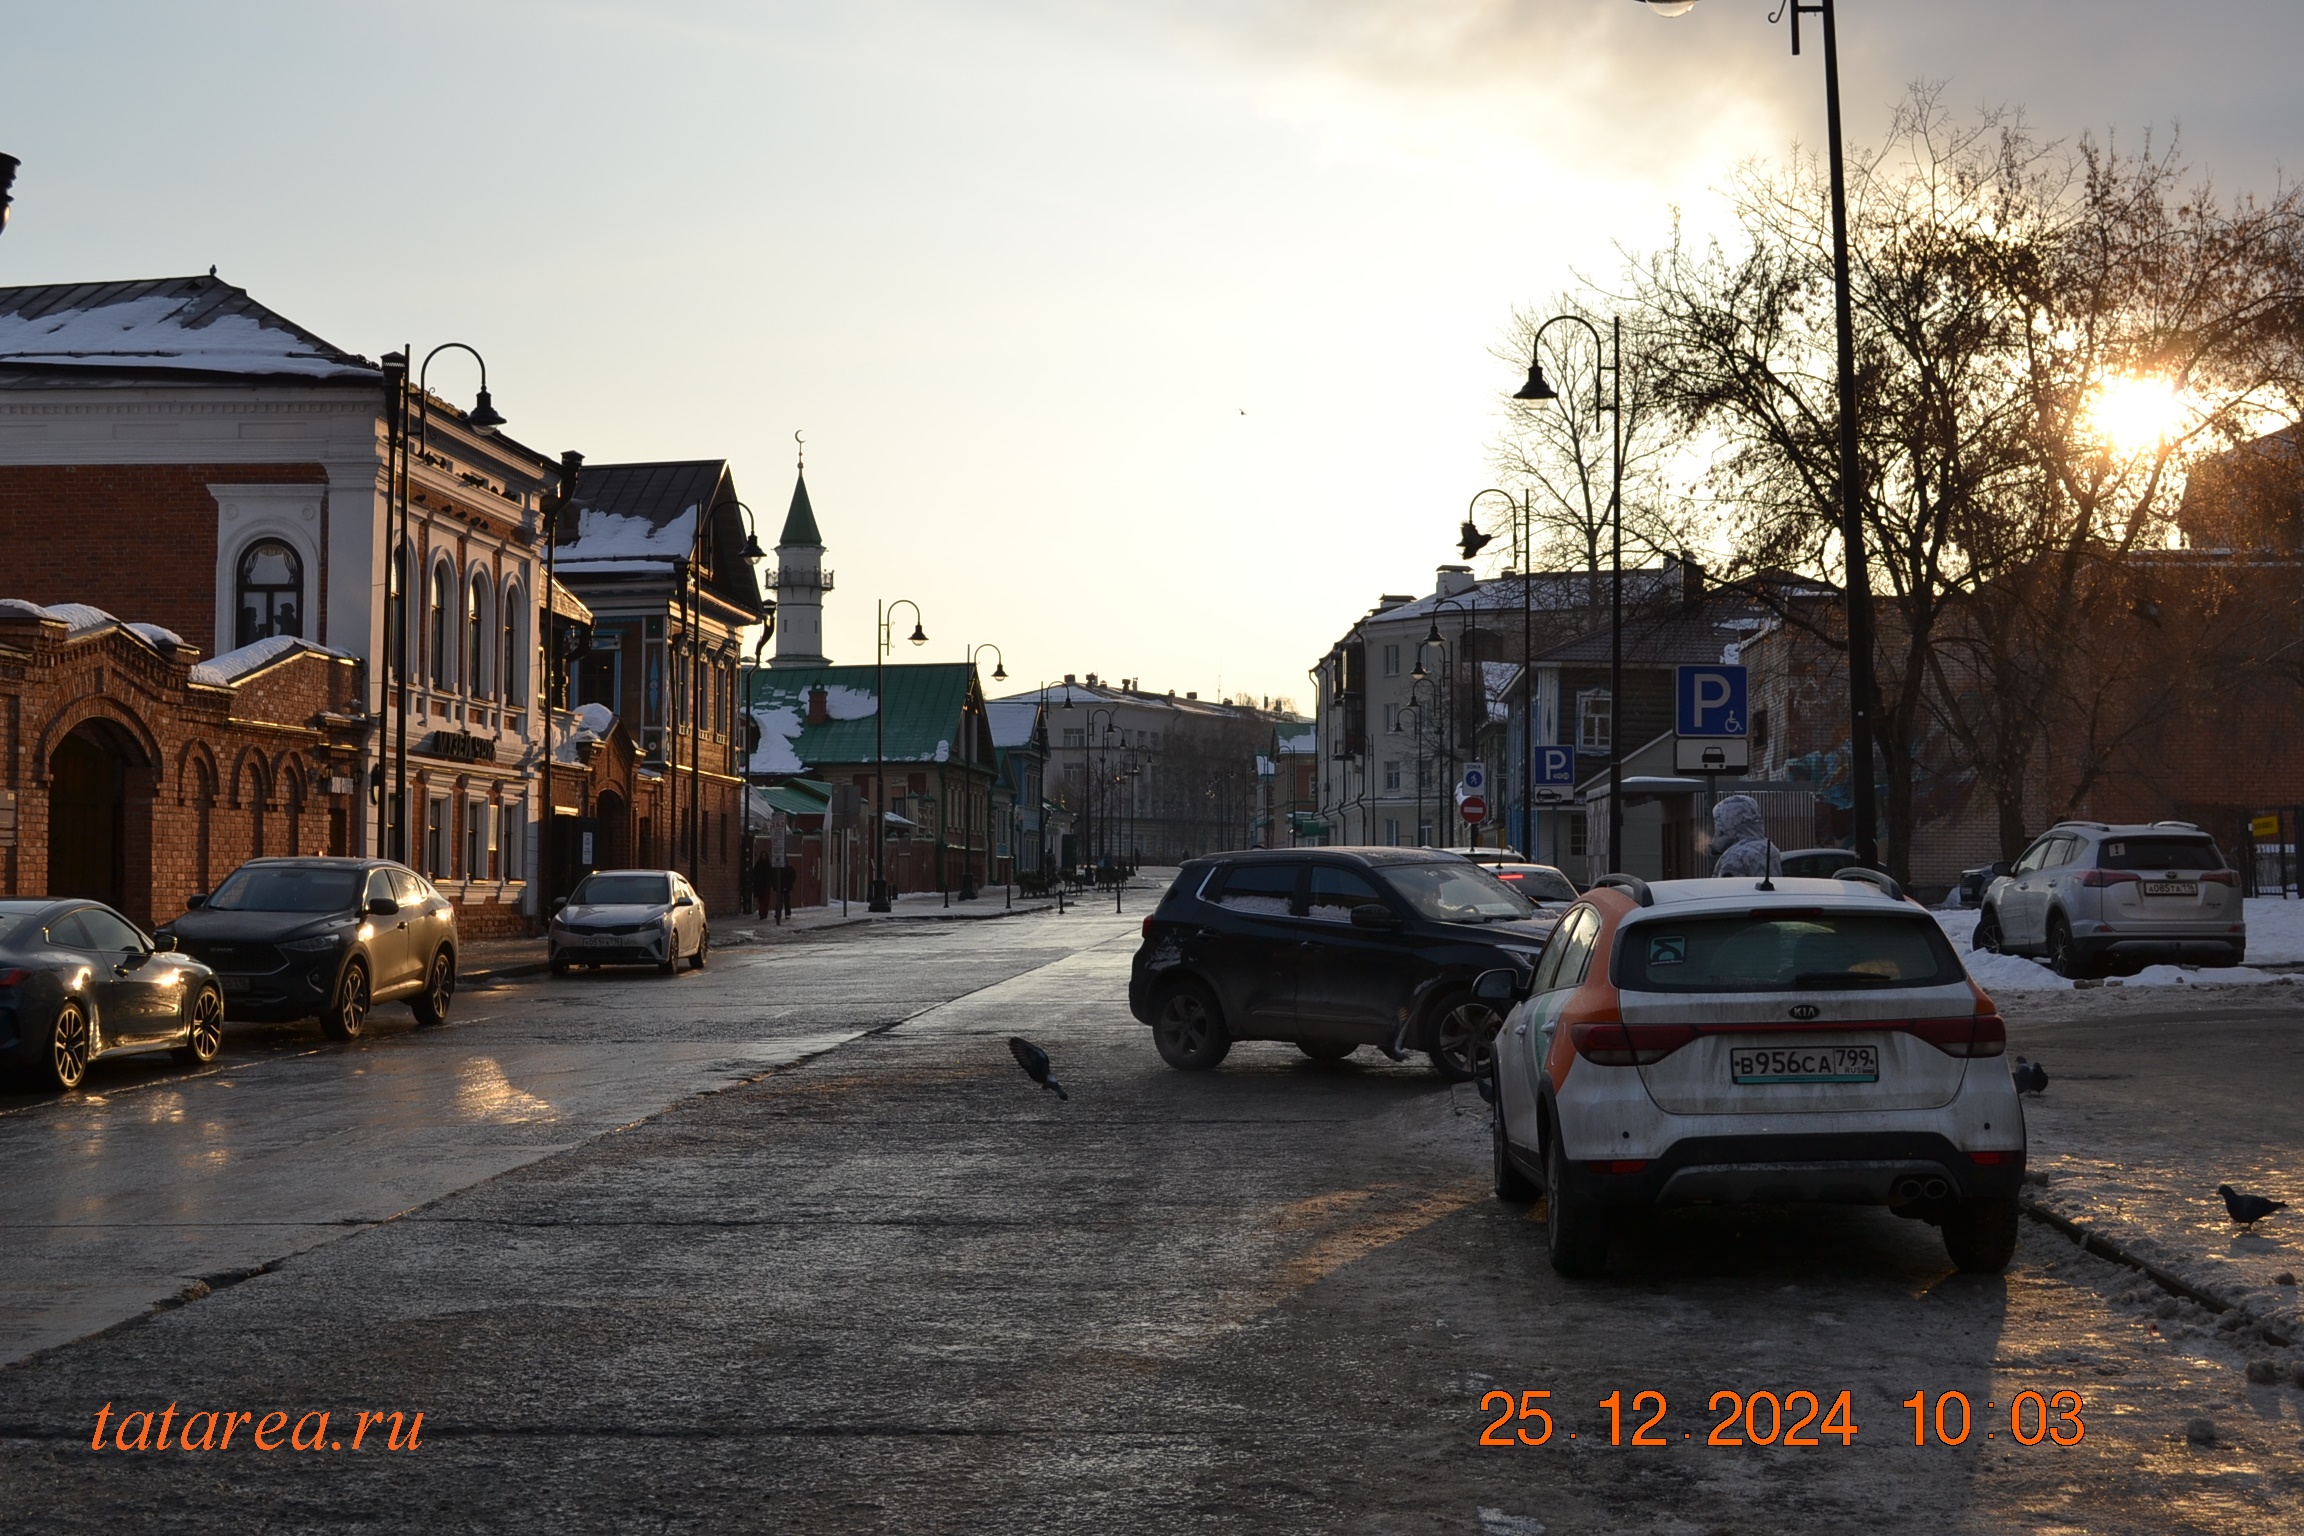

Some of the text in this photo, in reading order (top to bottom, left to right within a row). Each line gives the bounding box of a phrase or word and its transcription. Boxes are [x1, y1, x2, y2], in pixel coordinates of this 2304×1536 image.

[1694, 673, 1731, 727] P
[439, 730, 472, 758] МУЗЕЙ
[1545, 750, 1567, 780] P
[1794, 1007, 1816, 1017] KIA
[1741, 1049, 1870, 1075] В956СА 799
